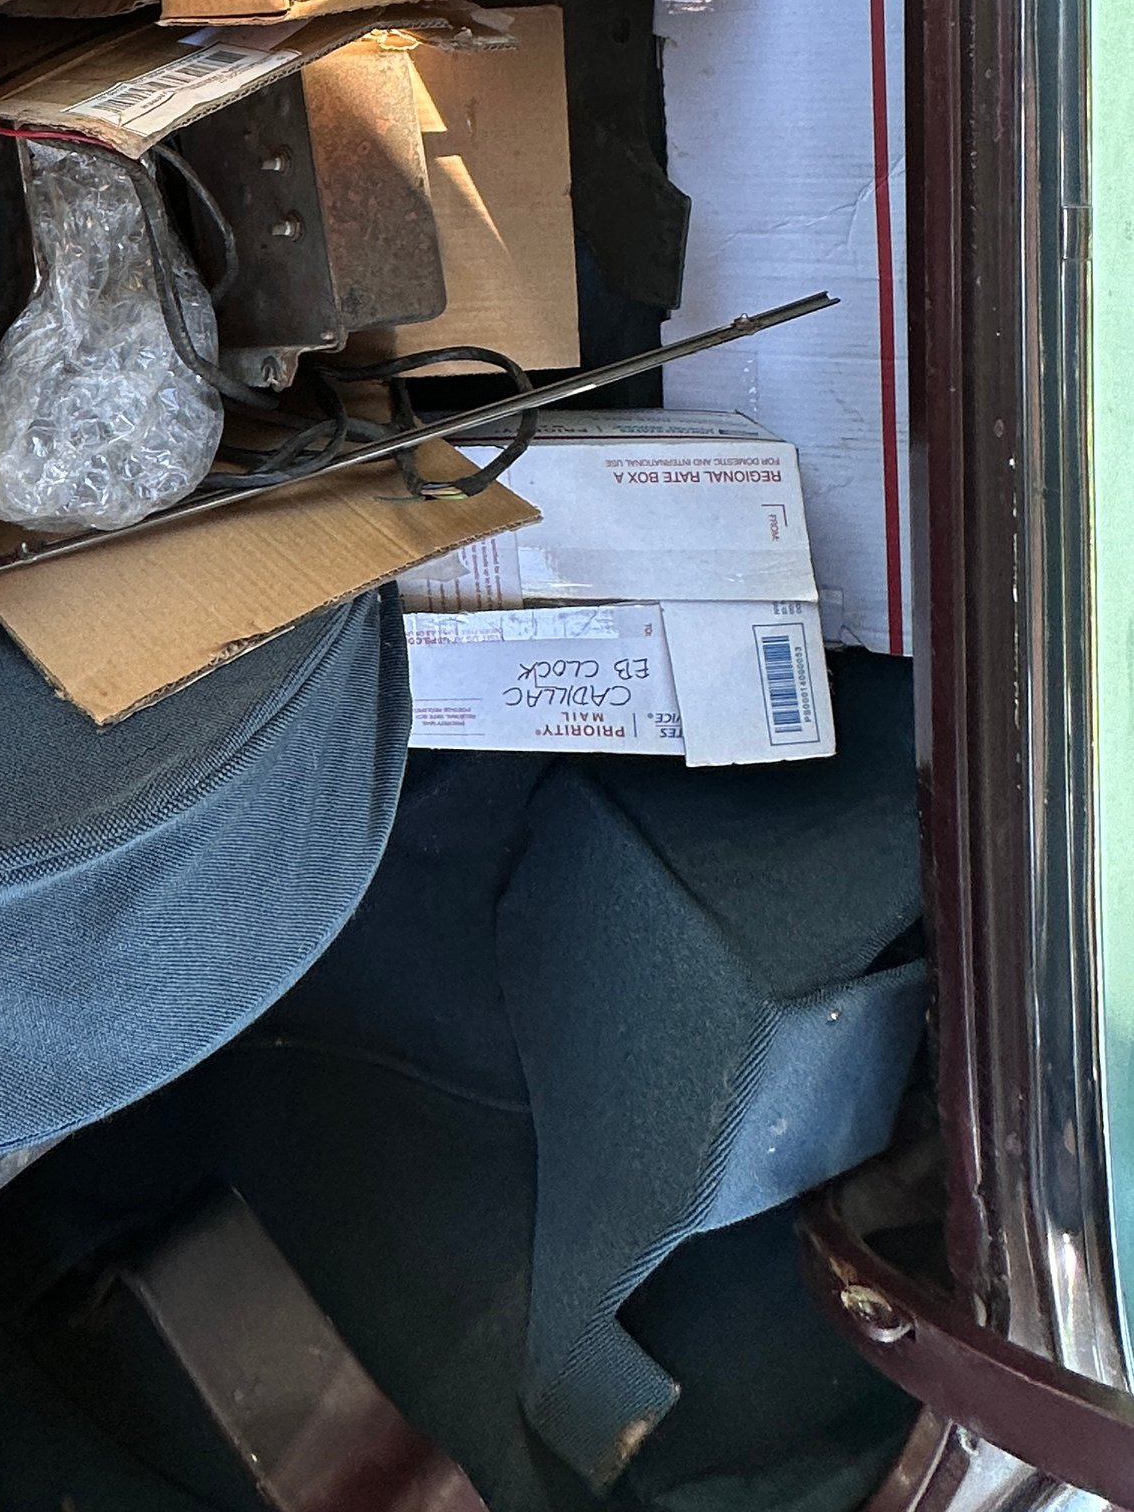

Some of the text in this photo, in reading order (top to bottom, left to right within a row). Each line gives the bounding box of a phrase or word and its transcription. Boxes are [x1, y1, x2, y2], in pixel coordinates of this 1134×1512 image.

[605, 459, 624, 468] USE
[624, 458, 692, 468] INTERNATIONAL
[693, 458, 712, 467] AND
[714, 457, 760, 467] DOMESTIC
[613, 470, 782, 485] REGIONAL RATE BOX A
[518, 657, 651, 683] EB CLOCK
[502, 684, 633, 709] CADILLAC
[561, 711, 605, 724] MAIL
[541, 724, 626, 739] PRIORITY
